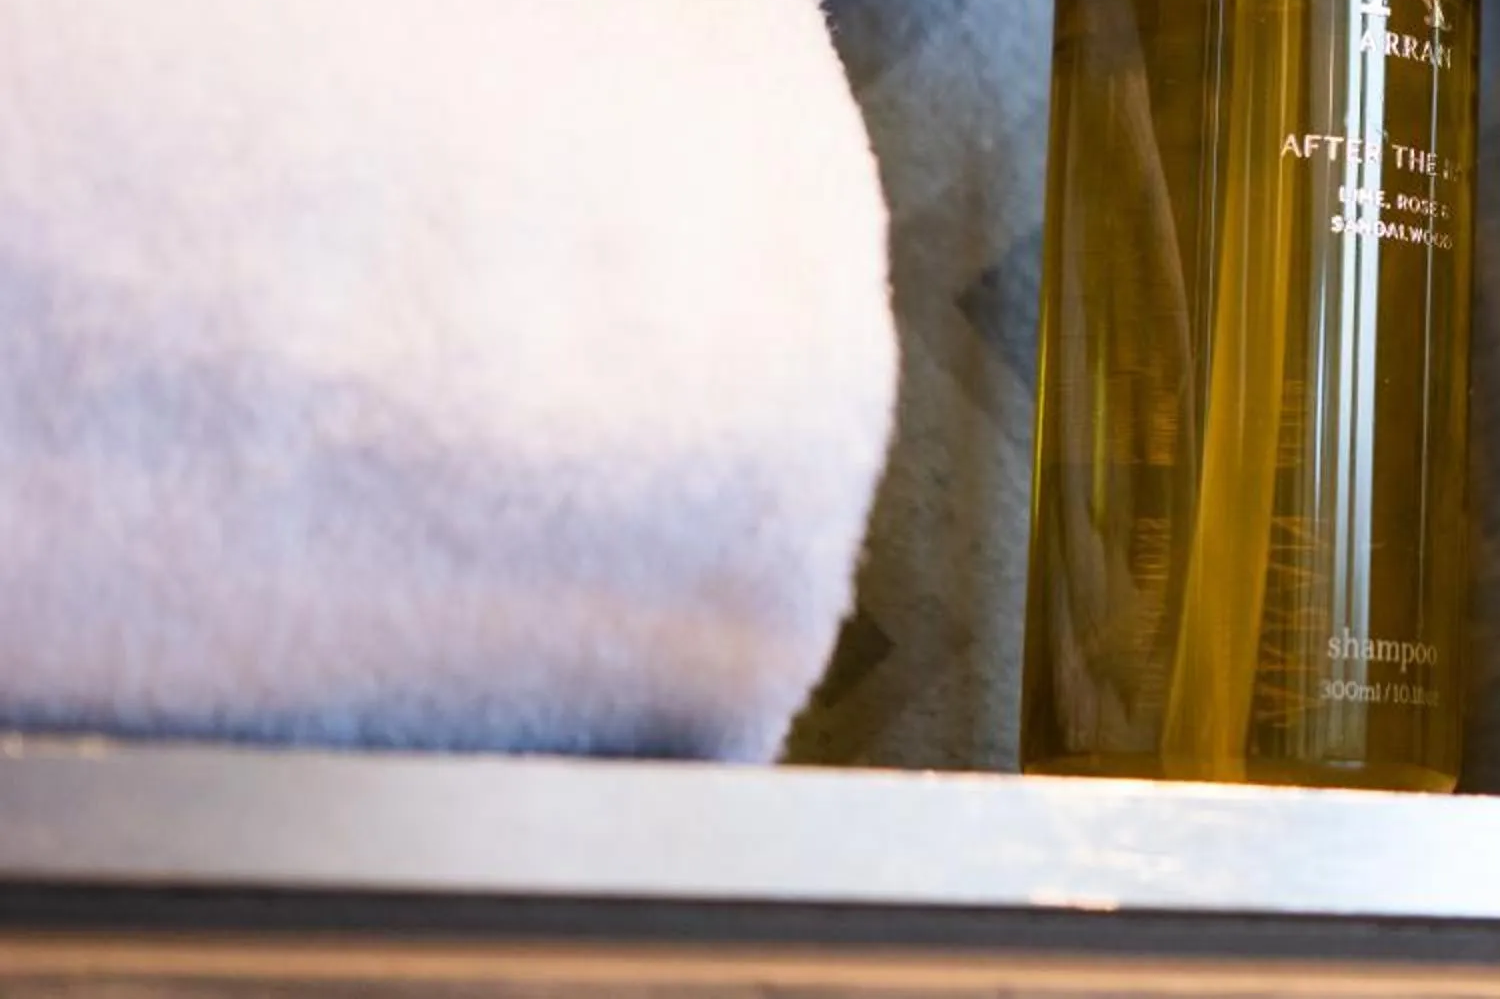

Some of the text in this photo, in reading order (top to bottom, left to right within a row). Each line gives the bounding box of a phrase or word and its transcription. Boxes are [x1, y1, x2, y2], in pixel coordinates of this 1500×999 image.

[1360, 30, 1451, 69] ARRAN
[1281, 134, 1381, 164] AFTER
[1392, 144, 1438, 177] THE
[1397, 194, 1437, 218] ROSE
[1327, 626, 1438, 673] shampoo
